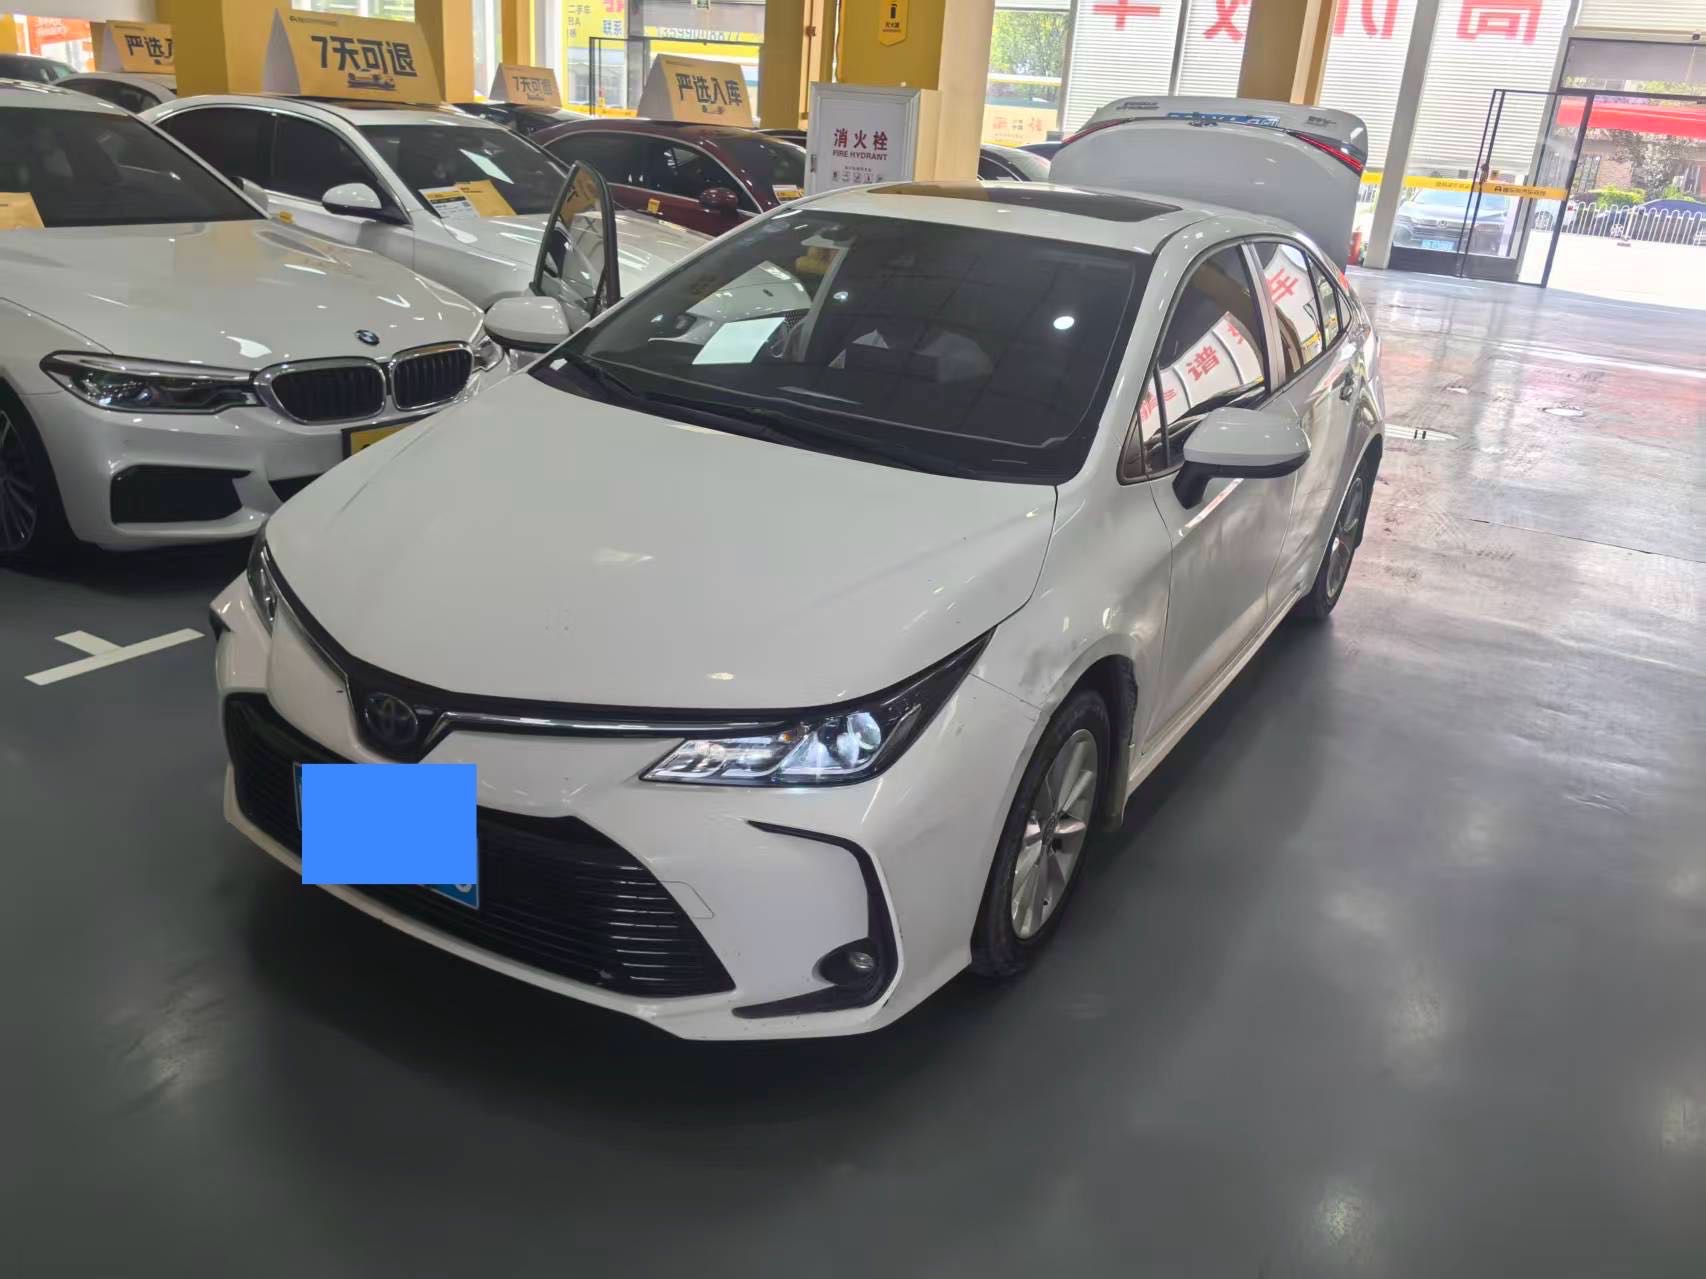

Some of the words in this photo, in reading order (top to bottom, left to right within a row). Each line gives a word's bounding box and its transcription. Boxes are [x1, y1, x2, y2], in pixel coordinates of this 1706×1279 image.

[311, 35, 417, 77] 7天可退
[675, 73, 742, 106] 严选入库
[833, 128, 888, 151] 消火栓
[832, 149, 849, 158] FIRE
[849, 151, 888, 161] HYDRANT
